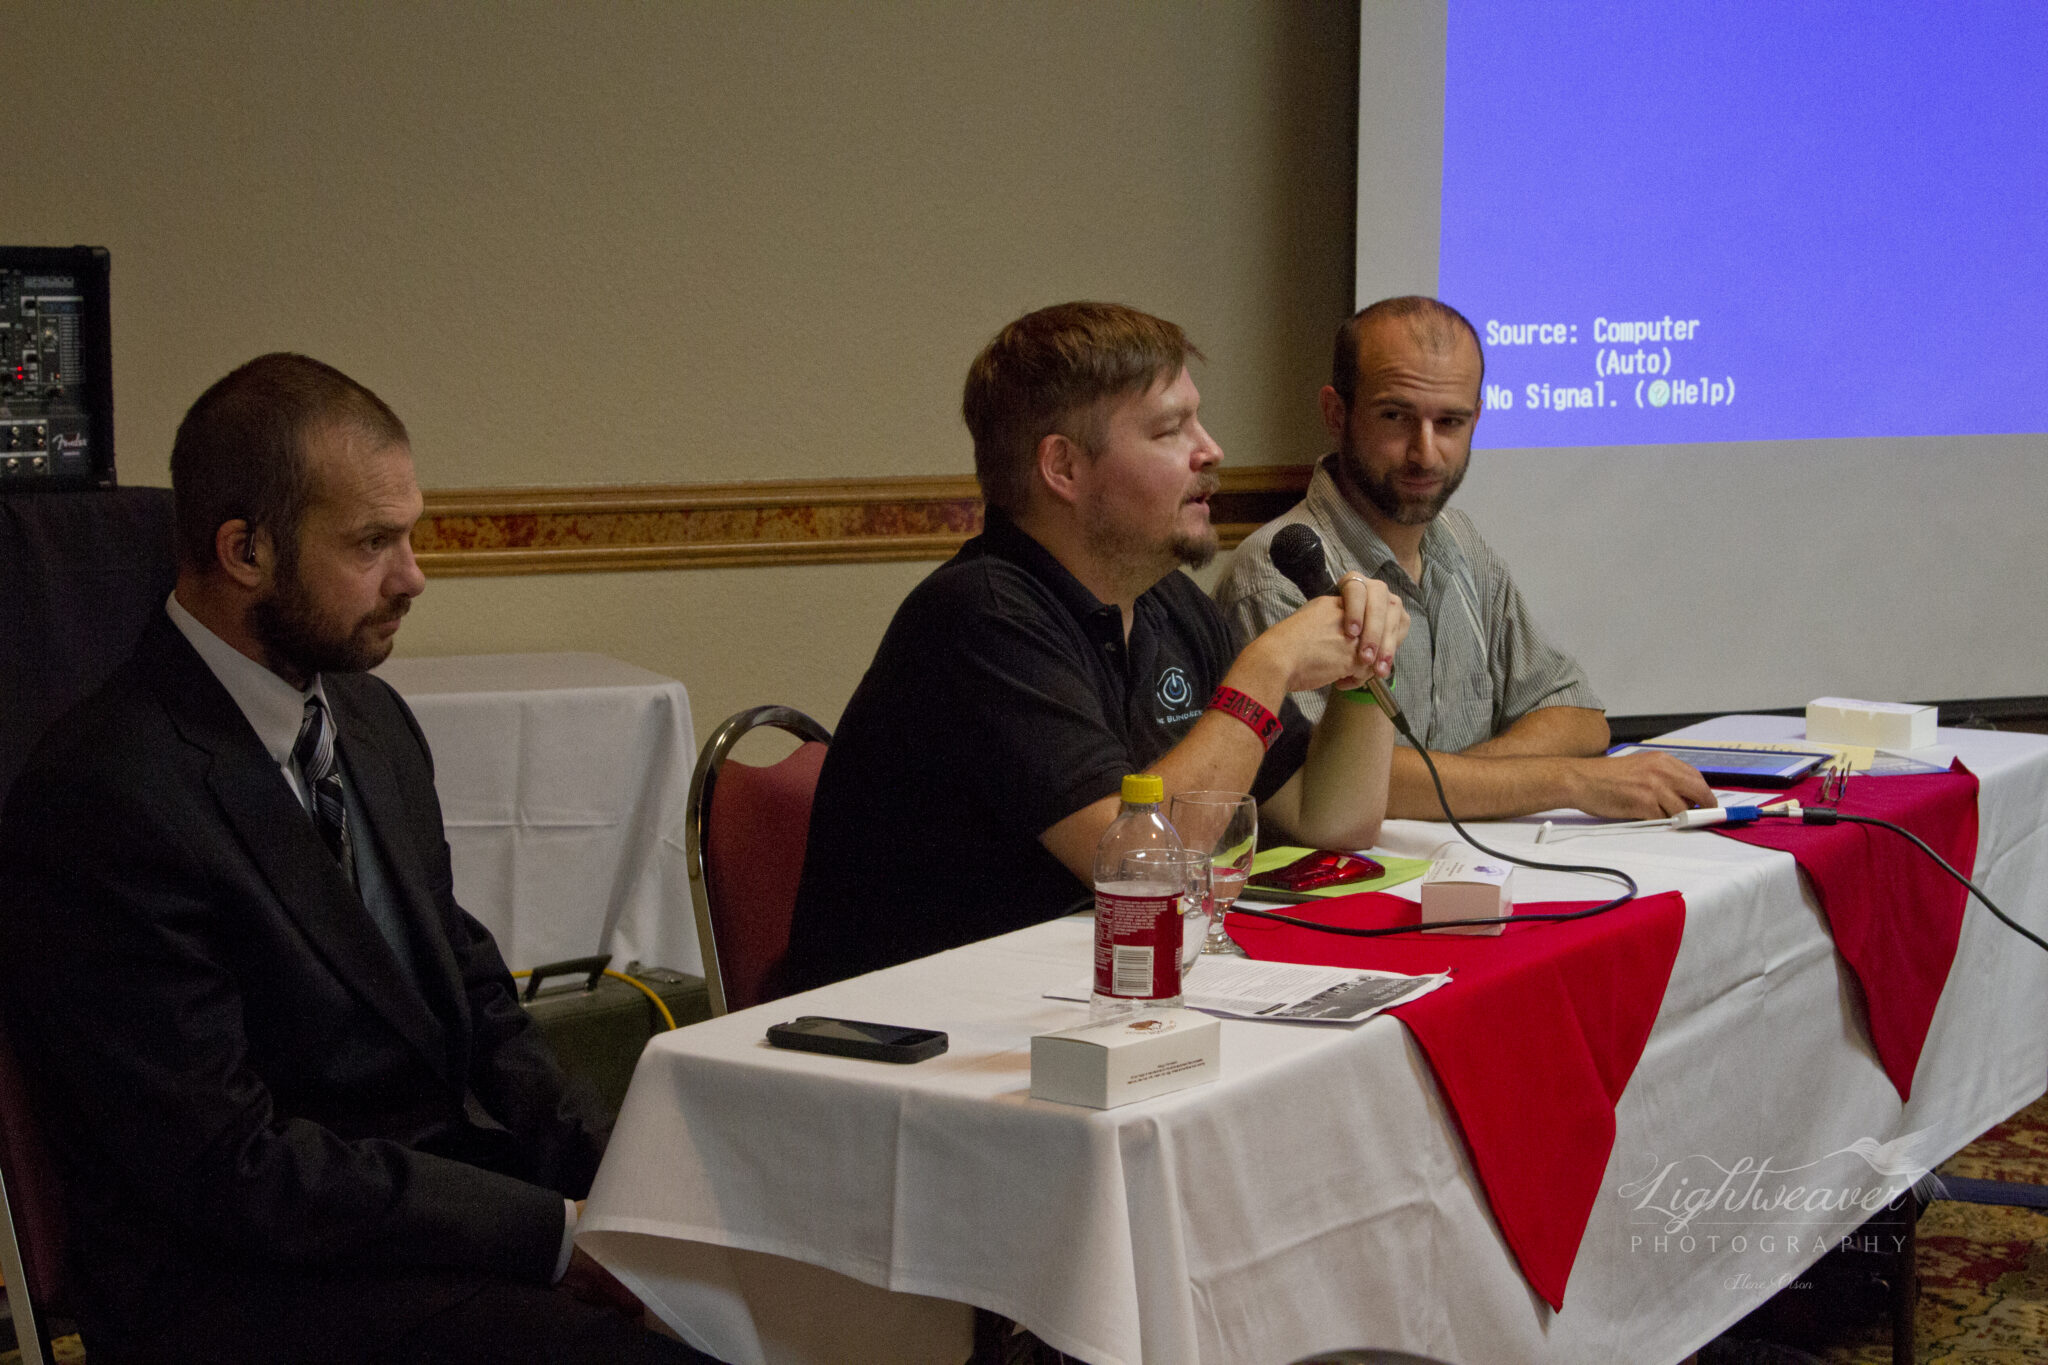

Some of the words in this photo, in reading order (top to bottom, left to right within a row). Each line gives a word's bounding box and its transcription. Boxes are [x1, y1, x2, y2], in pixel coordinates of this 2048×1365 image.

[1486, 319, 1578, 346] Source:
[1593, 315, 1700, 345] Computer
[1595, 346, 1672, 378] (Auto)
[1486, 384, 1513, 410] No
[1526, 381, 1617, 411] Signal.
[1223, 690, 1265, 727] HAVE
